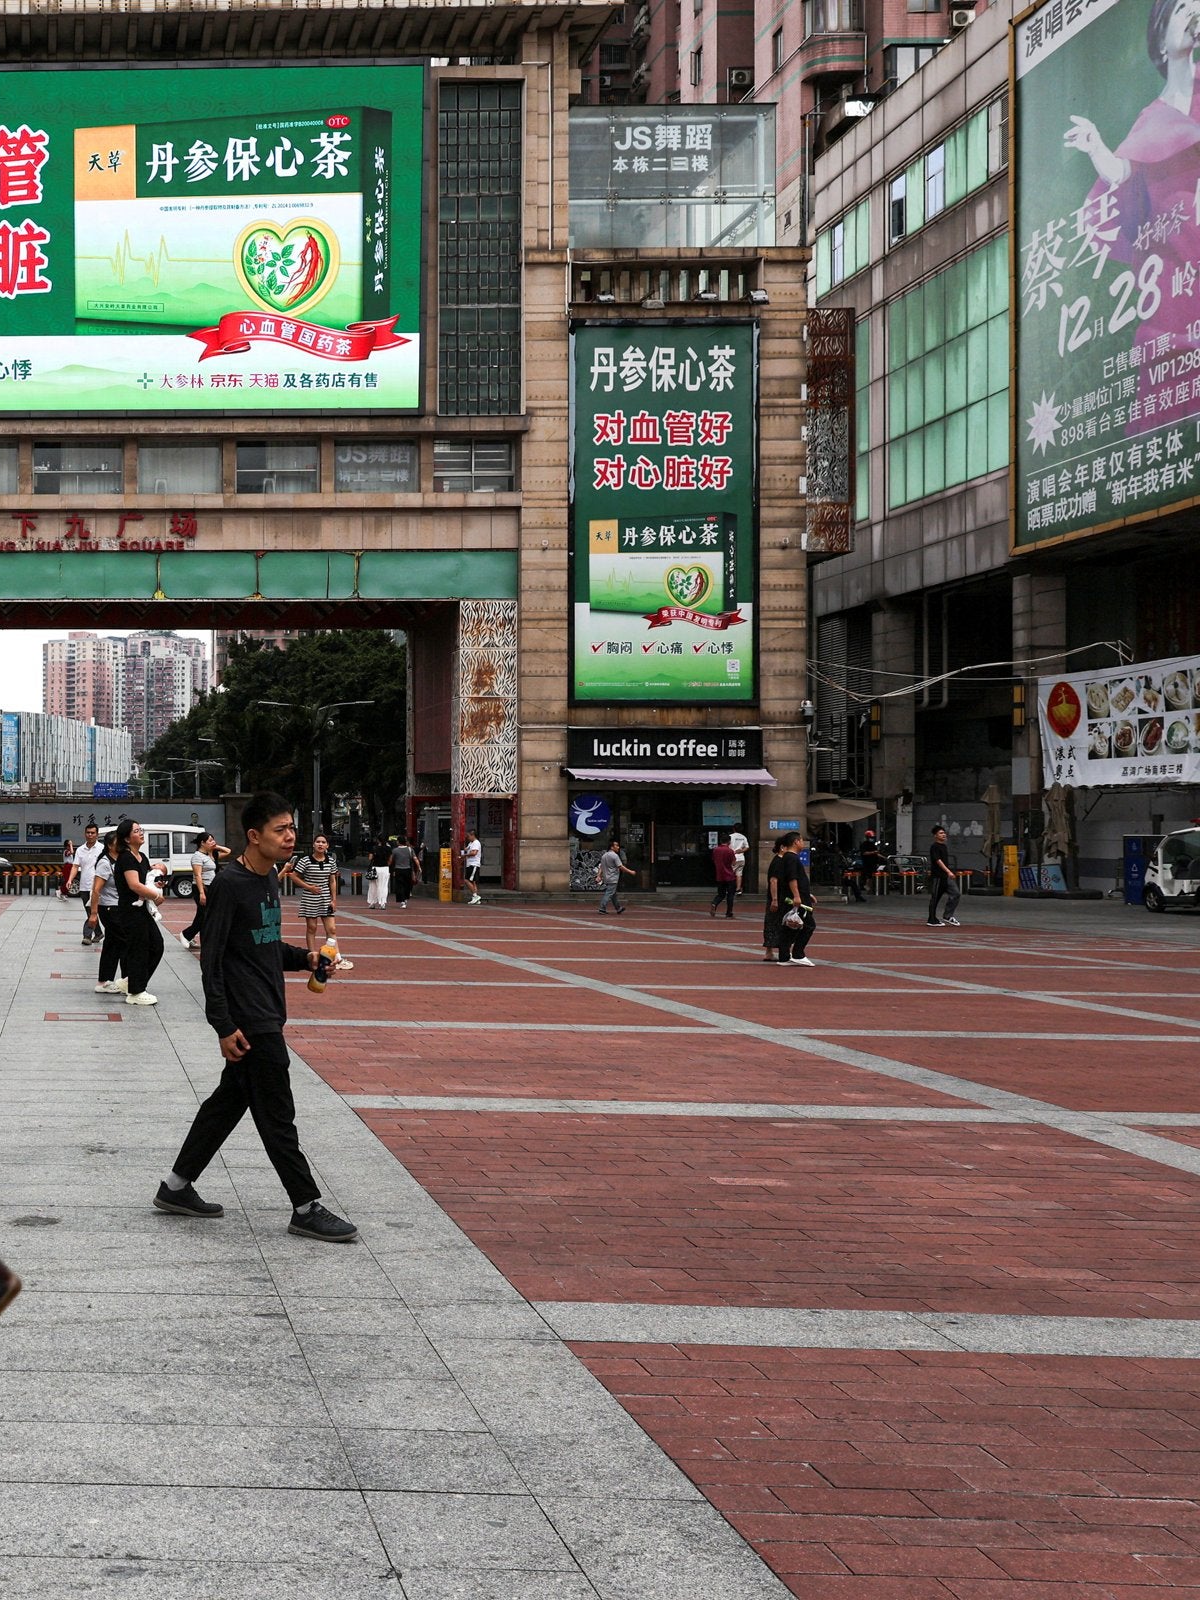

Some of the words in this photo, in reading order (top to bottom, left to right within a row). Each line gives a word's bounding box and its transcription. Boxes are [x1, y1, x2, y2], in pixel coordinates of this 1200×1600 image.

[1025, 0, 1097, 57] 演唱会
[327, 115, 349, 127] OTC
[614, 123, 713, 151] JS舞蹈
[88, 151, 122, 173] 天草
[146, 132, 352, 183] 丹参保心茶
[1021, 184, 1121, 318] 蔡琴
[239, 317, 353, 356] 心血管国药茶
[590, 345, 735, 392] 丹参保心茶
[159, 373, 205, 389] 大参林
[210, 374, 243, 388] 京东
[249, 373, 280, 389] 天猫
[283, 373, 379, 389] 及各药店有售
[593, 409, 733, 446] 对血管好
[593, 455, 733, 490] 对心脏好
[35, 541, 64, 551] XIA
[118, 541, 186, 551] SQUARE
[623, 523, 719, 546] 丹参保心茶
[606, 641, 633, 655] 胸闷
[657, 641, 683, 655] 心痛
[707, 641, 734, 655] 心悸
[593, 739, 650, 757] luckin
[656, 739, 718, 757] coffee
[728, 739, 746, 748] 瑞幸
[728, 749, 746, 757] 咖啡
